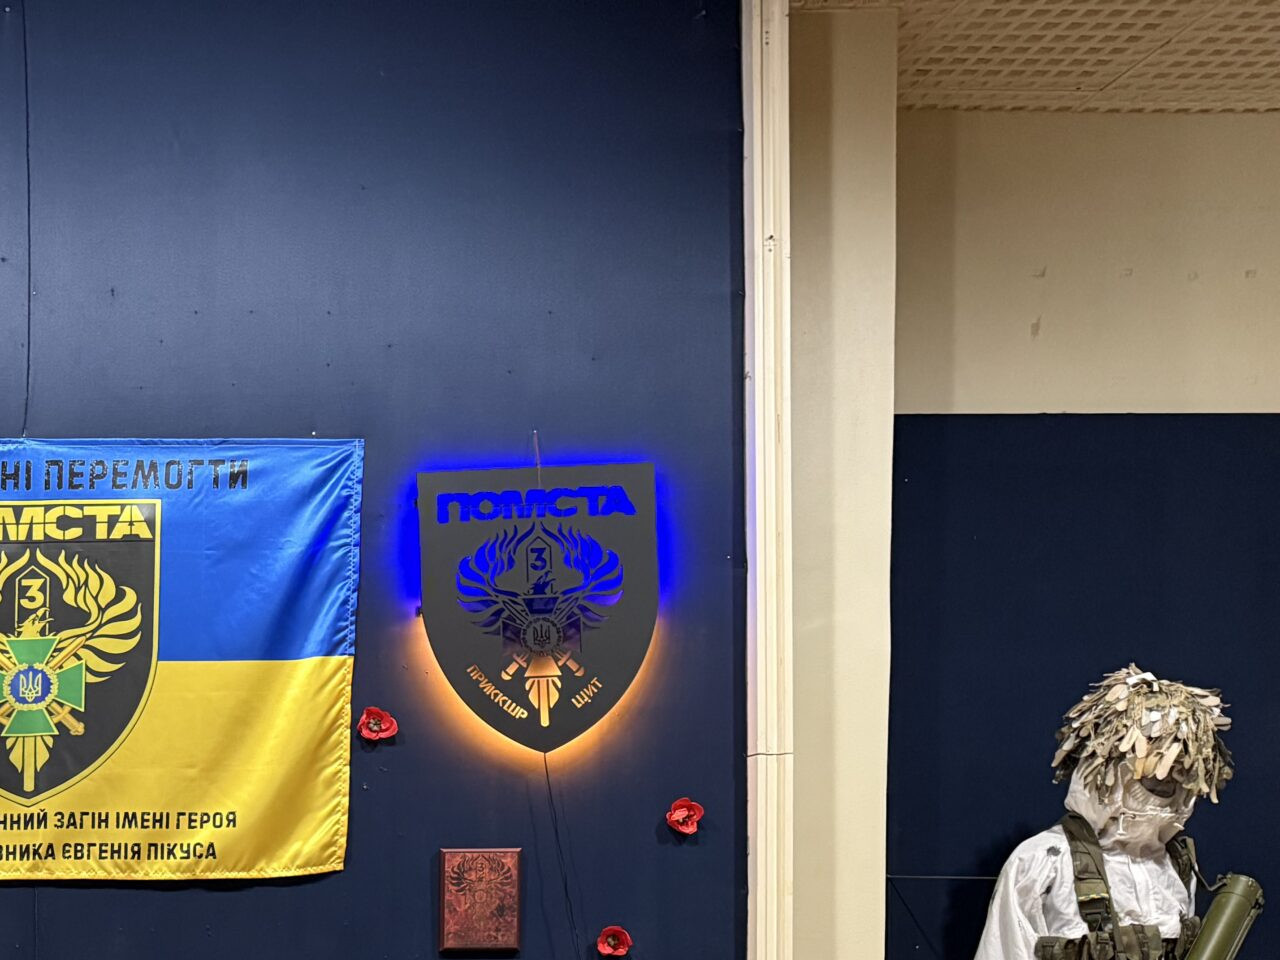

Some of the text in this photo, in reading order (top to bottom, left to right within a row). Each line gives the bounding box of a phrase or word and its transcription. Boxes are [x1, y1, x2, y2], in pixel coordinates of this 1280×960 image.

[44, 459, 249, 490] ПЕРЕМОГТИ
[437, 485, 637, 524] ПОМСТА
[530, 547, 546, 571] 3
[19, 578, 46, 610] 3
[571, 677, 603, 709] ЩИТ
[54, 811, 109, 830] ЗАГІН
[115, 811, 170, 830] ІМЕНІ
[176, 811, 237, 830] ГЕРОЯ
[62, 842, 141, 861] ЄВГЕНІЯ
[147, 842, 217, 861] ПІКУСА
